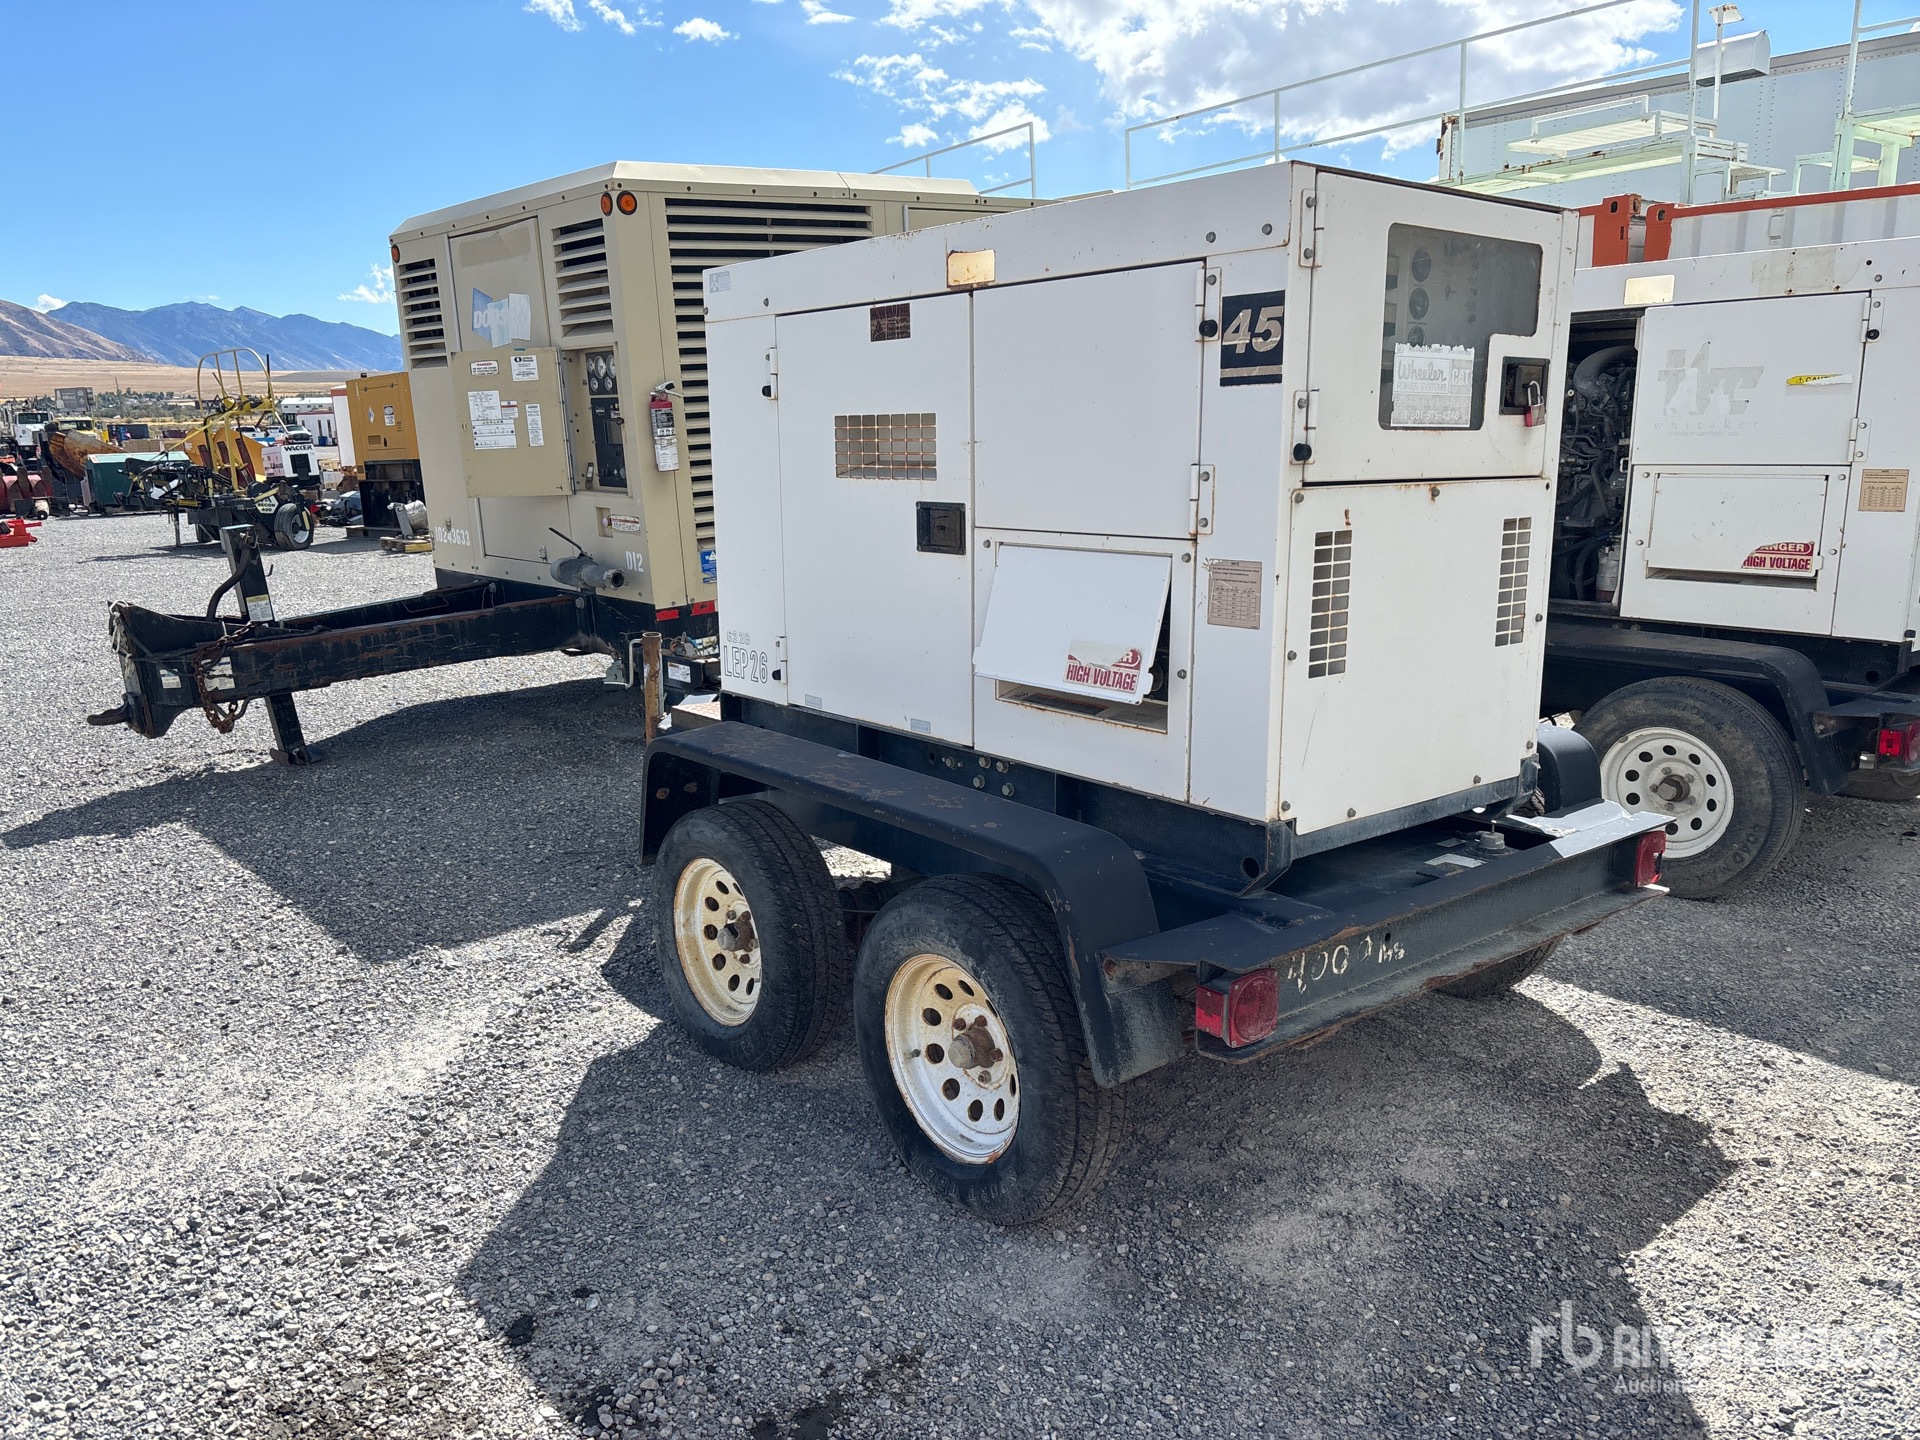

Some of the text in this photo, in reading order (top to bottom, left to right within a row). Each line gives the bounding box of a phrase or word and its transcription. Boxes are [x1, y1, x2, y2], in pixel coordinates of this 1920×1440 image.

[1222, 305, 1284, 354] 45
[1397, 359, 1447, 382] Wheeler
[1452, 367, 1470, 386] CAT
[1396, 381, 1447, 391] POWER SYSTEMS
[1760, 543, 1804, 552] ANGER
[1743, 555, 1811, 570] HIGH VOLTAGE
[1066, 663, 1137, 691] HIGH VOLTAGE
